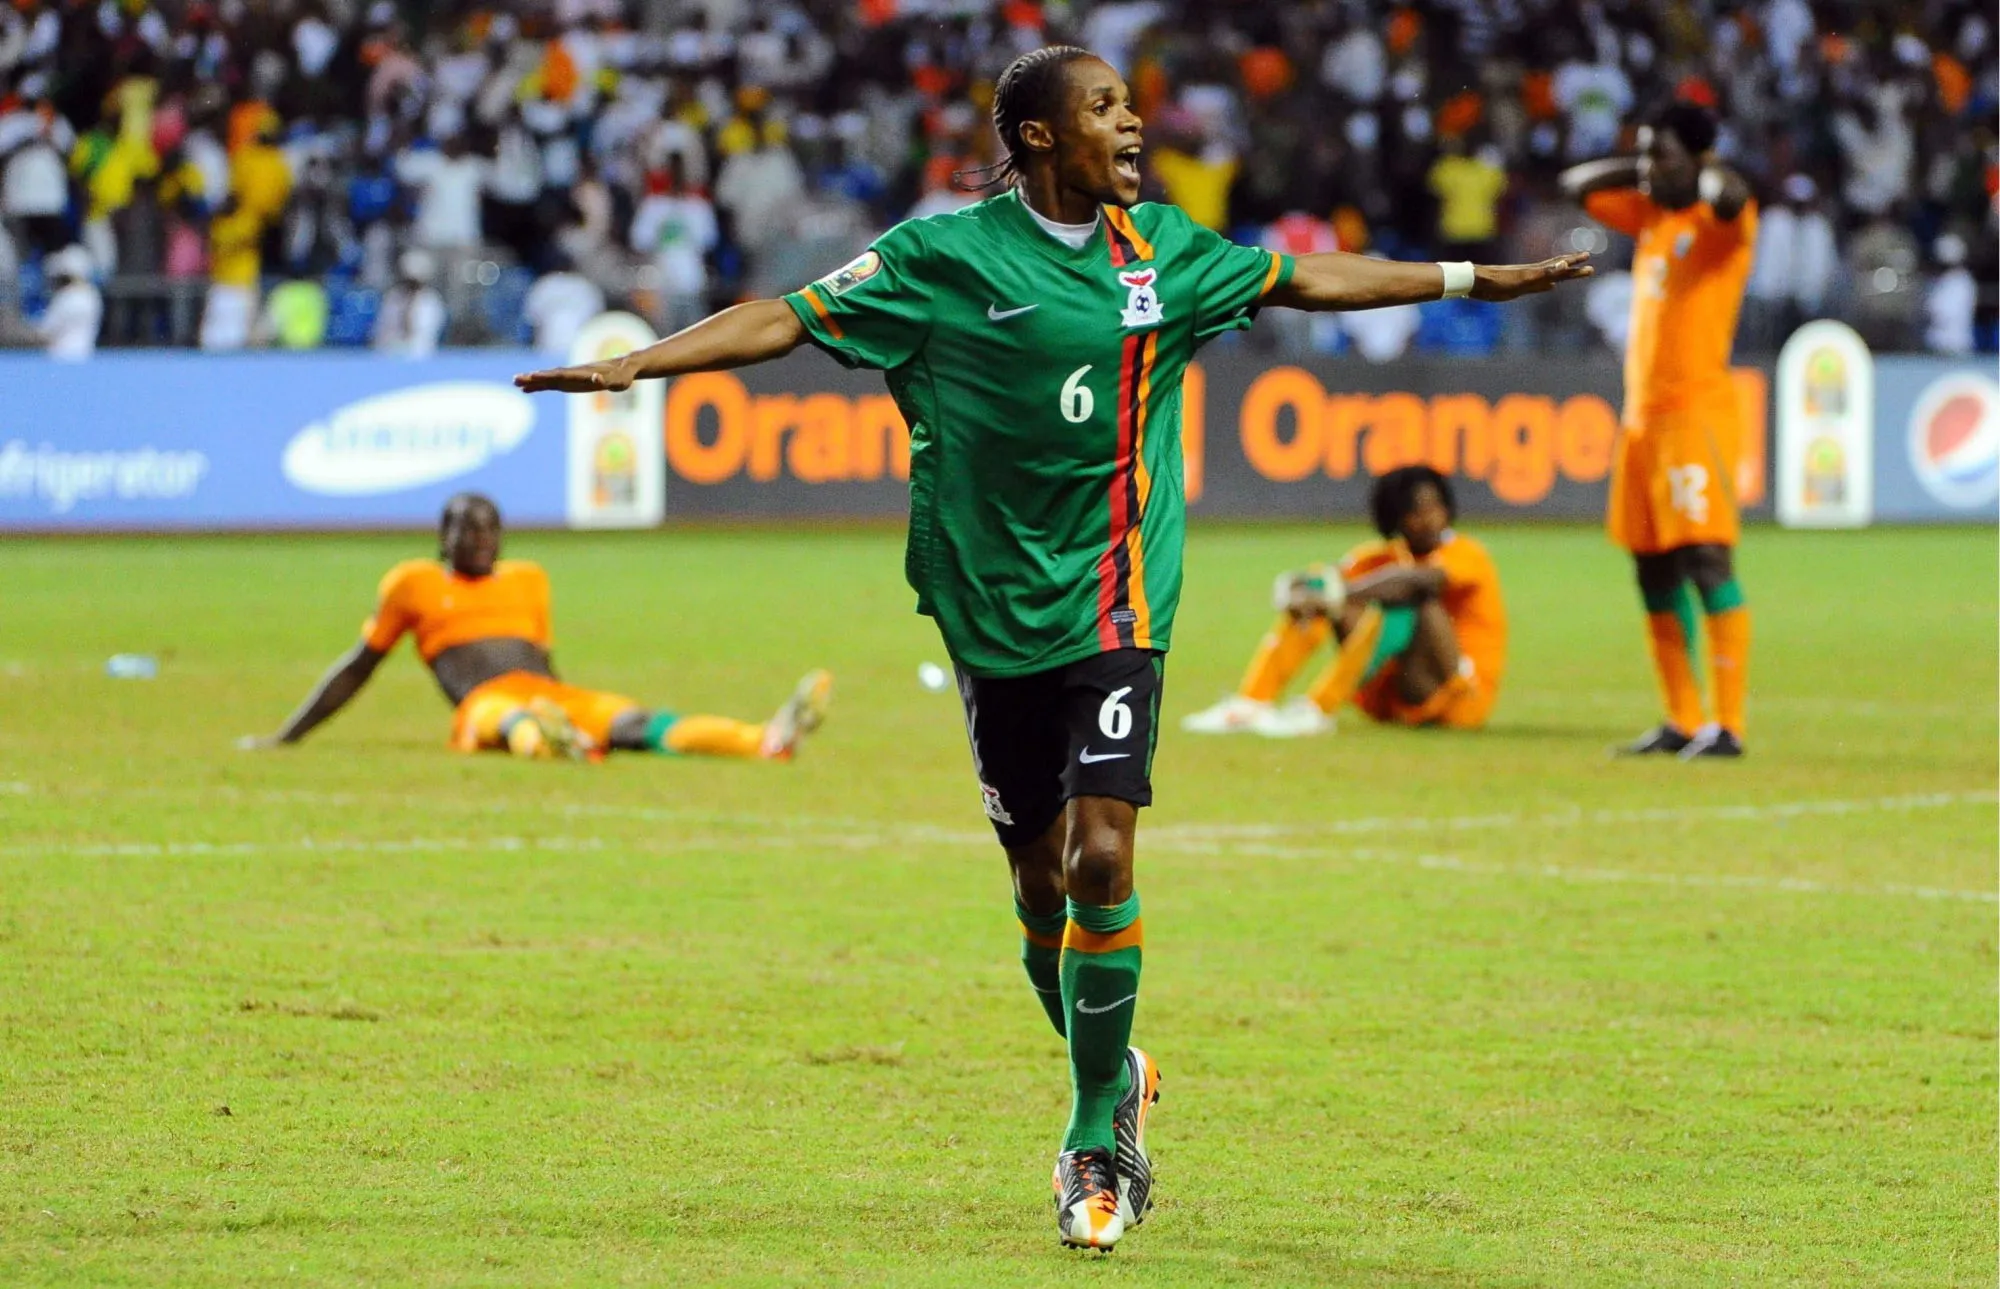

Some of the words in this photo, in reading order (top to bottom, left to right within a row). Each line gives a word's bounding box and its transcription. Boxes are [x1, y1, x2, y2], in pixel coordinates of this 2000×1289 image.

[1060, 364, 1094, 423] 6
[666, 371, 911, 483] Oran
[1240, 366, 1618, 503] Orange
[1668, 464, 1707, 524] 12
[1098, 686, 1133, 739] 6
